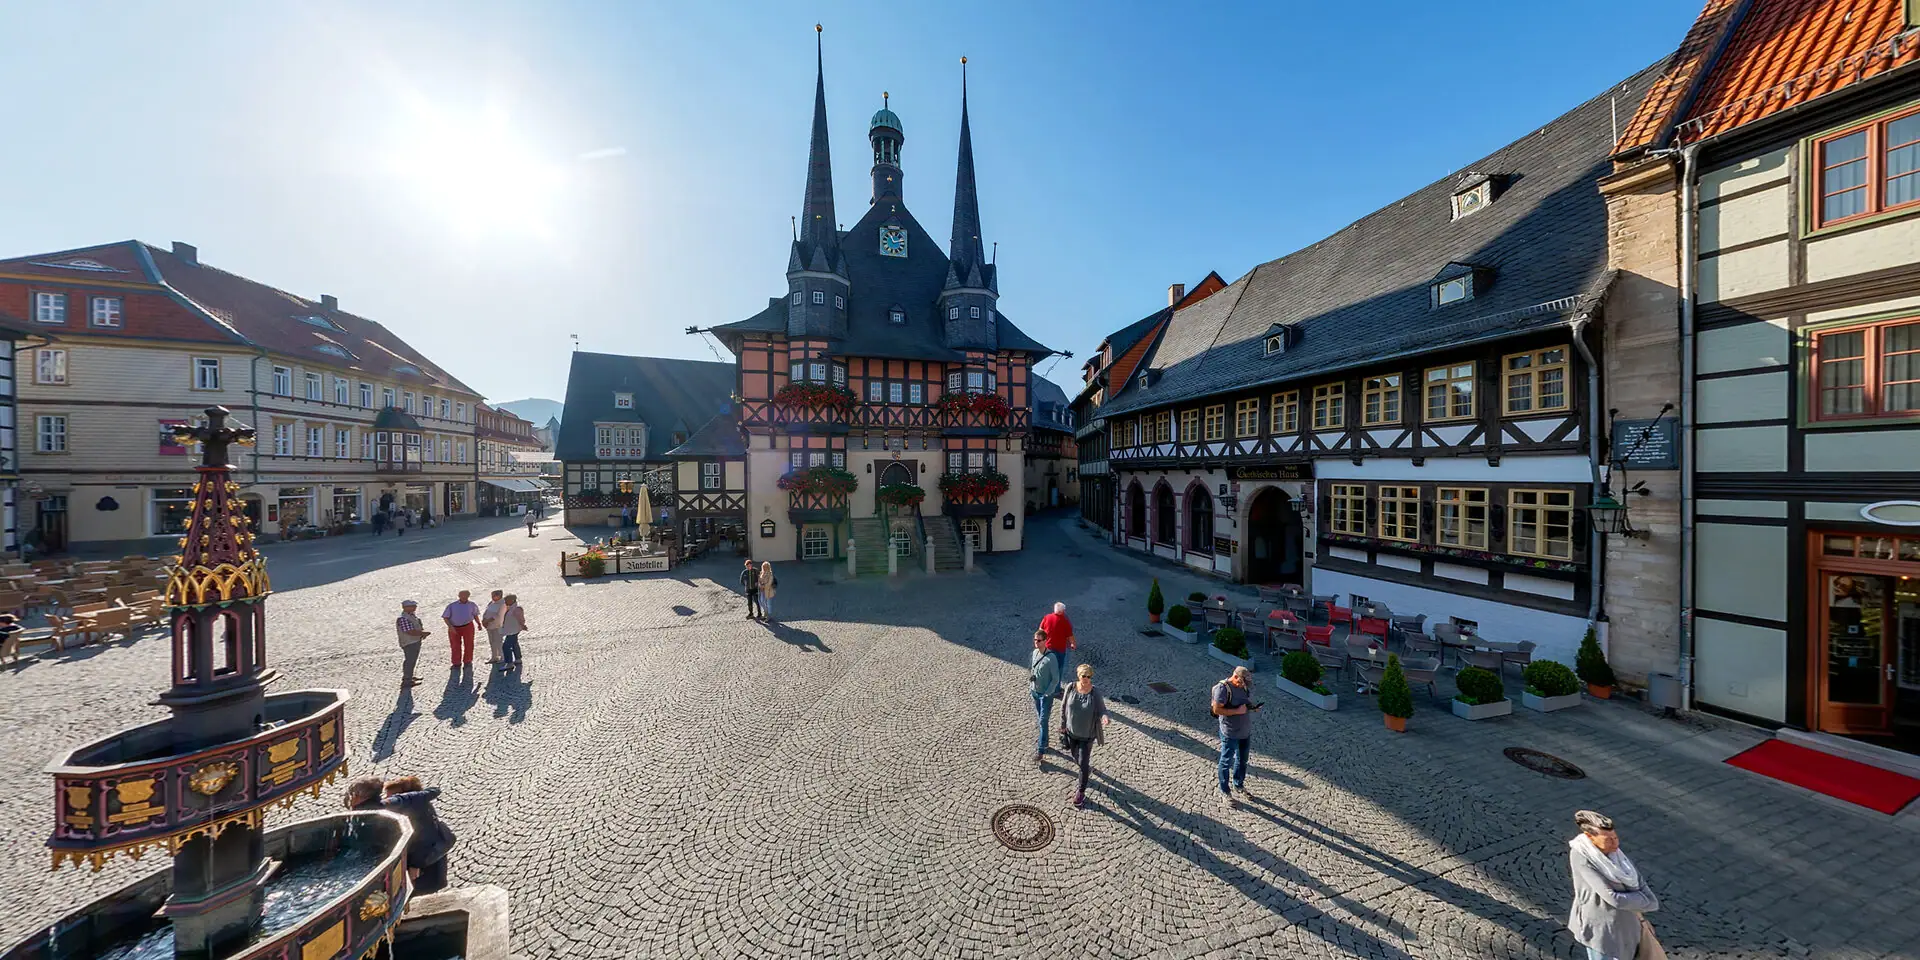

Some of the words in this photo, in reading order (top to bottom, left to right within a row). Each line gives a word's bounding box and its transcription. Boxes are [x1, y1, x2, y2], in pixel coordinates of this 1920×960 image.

[1236, 466, 1277, 478] Gothisches
[1279, 470, 1299, 478] Haus
[626, 560, 663, 570] Ratskeller
